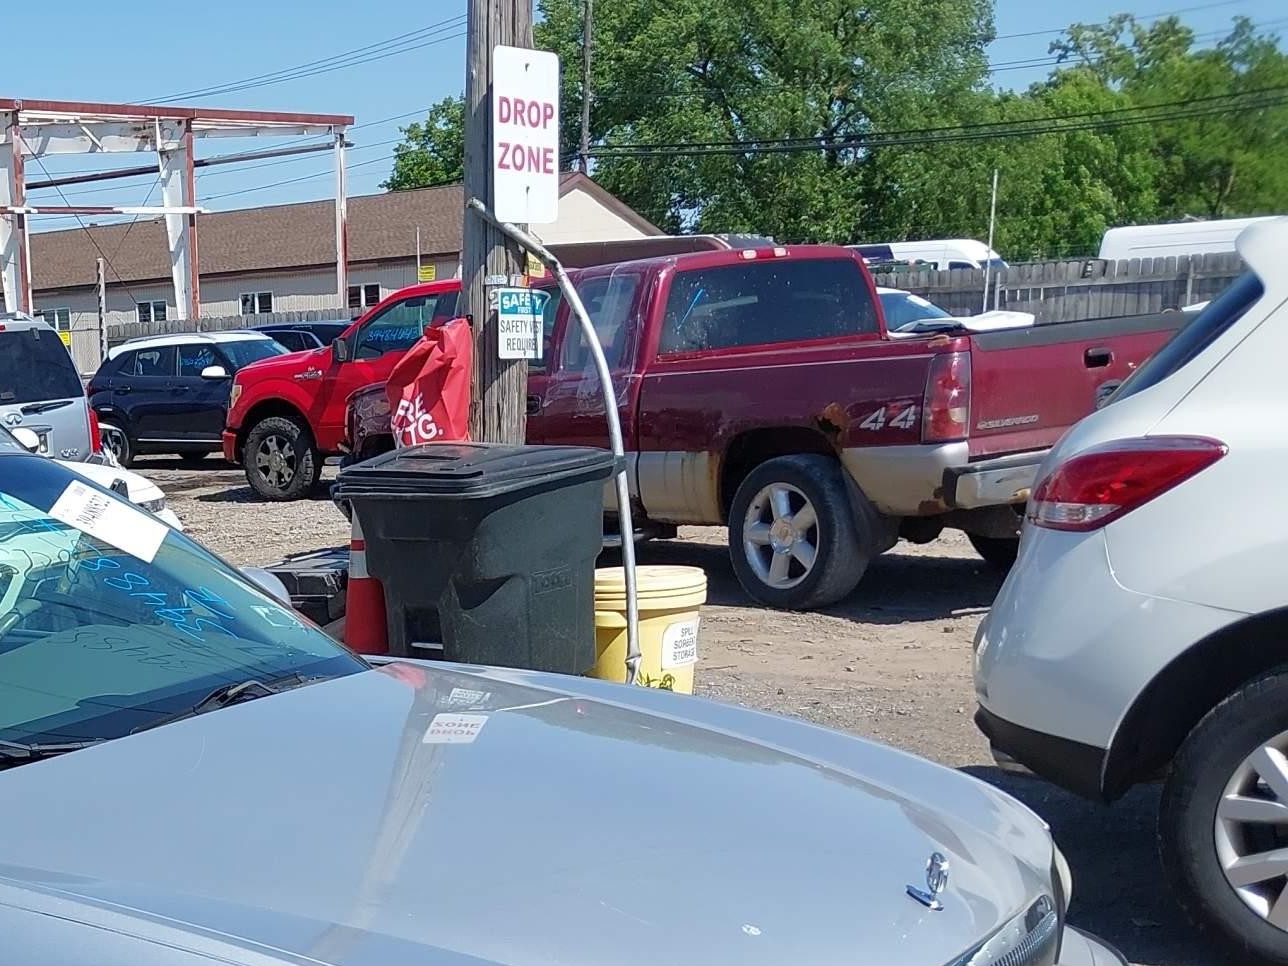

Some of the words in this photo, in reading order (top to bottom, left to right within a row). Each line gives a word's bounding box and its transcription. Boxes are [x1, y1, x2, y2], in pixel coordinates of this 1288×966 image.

[499, 96, 554, 129] DROP
[498, 142, 554, 174] ZONE
[500, 320, 529, 333] SAFETY
